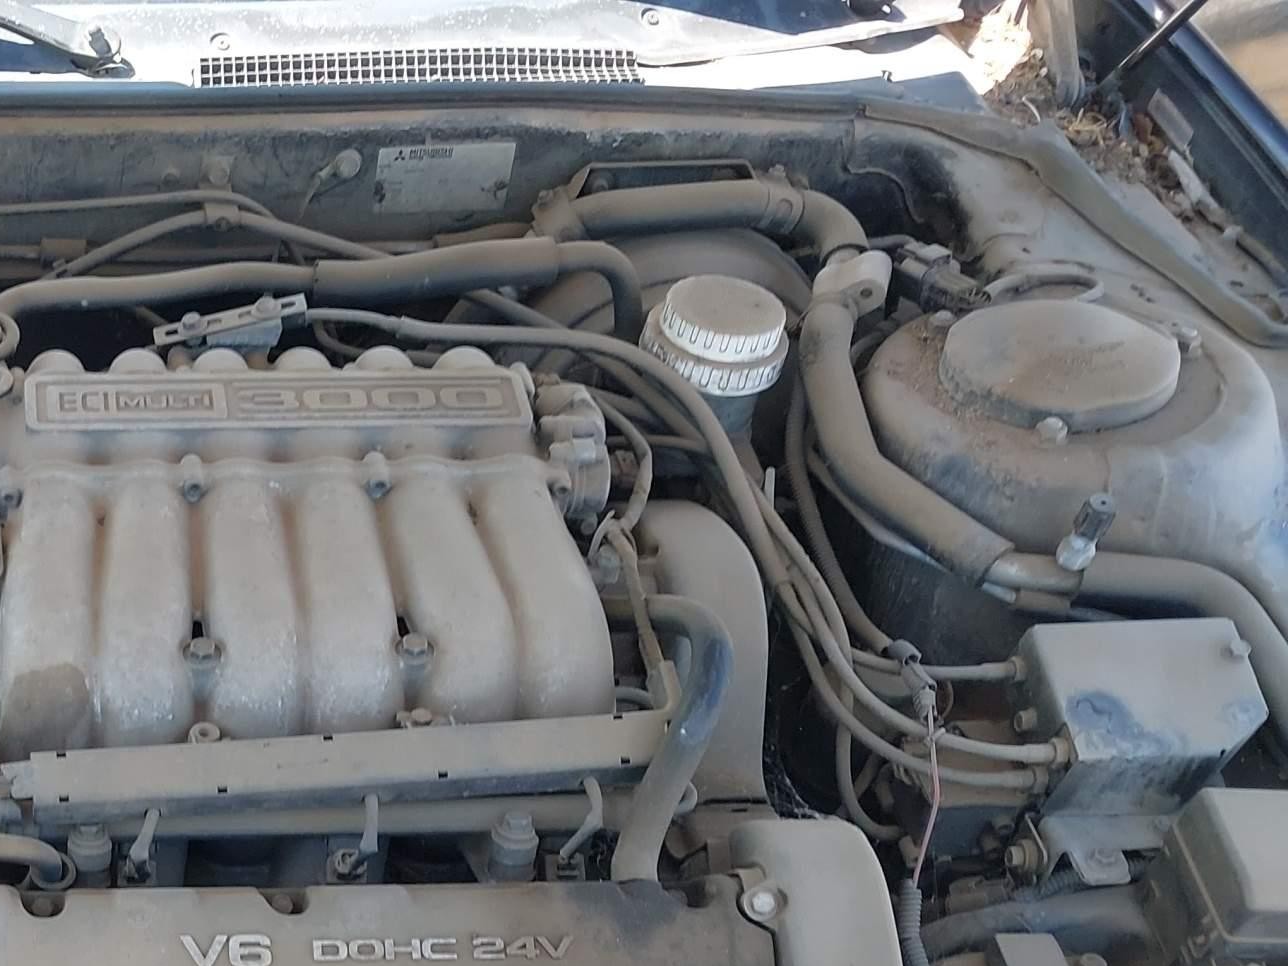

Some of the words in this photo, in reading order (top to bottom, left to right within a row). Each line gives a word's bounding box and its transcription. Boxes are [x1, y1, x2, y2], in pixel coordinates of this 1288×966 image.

[58, 391, 110, 412] ECI
[116, 391, 212, 412] MULTI
[236, 387, 503, 411] 3000
[312, 937, 457, 962] DOHC
[472, 935, 573, 961] 24V
